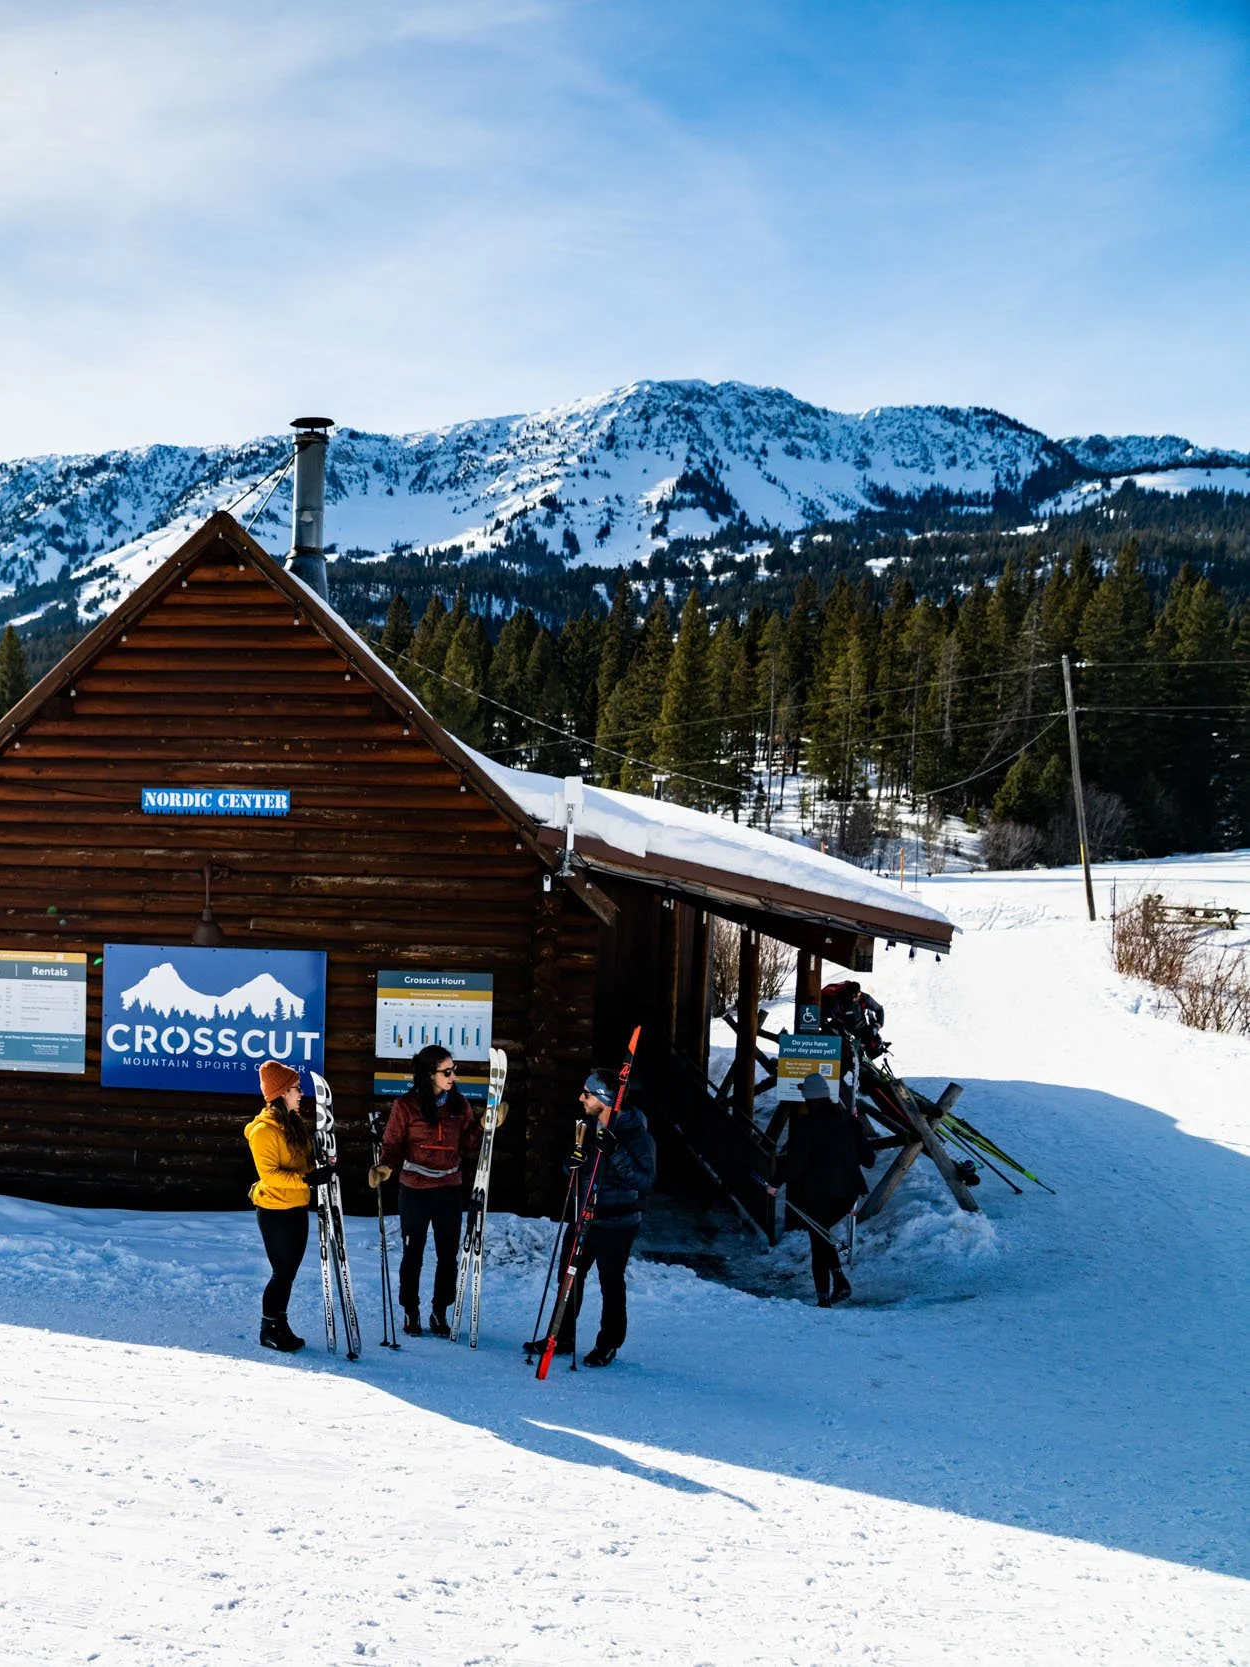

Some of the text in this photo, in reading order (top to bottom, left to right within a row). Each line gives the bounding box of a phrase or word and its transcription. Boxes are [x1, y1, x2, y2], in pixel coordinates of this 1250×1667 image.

[144, 791, 288, 809] NORDIC CENTER
[31, 966, 69, 977] Rentals
[404, 976, 466, 986] Crosscut Hours
[106, 1023, 320, 1060] CROSSCUT
[123, 1057, 306, 1074] MOUNTAIN SPORTS CER
[323, 1270, 333, 1327] ROSSIGNOL
[342, 1270, 356, 1327] ROSSIGNOL
[455, 1272, 465, 1317] ROSSIGNOL
